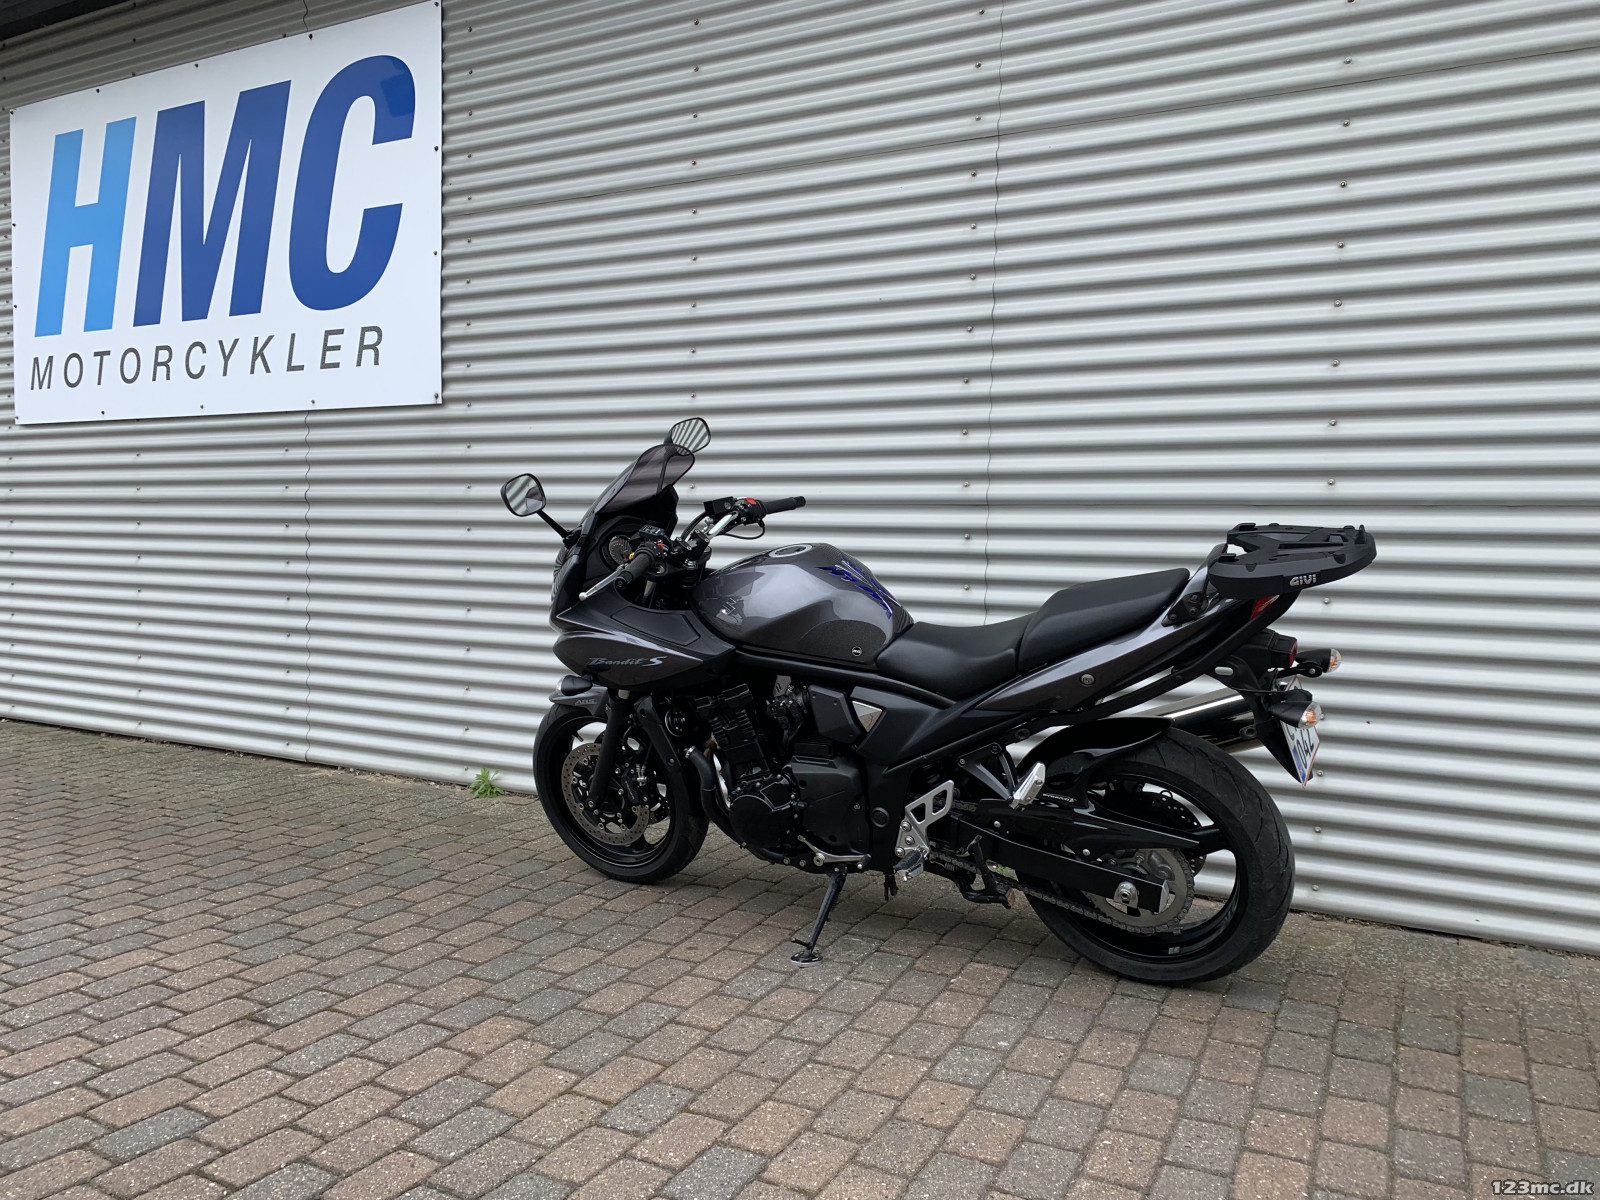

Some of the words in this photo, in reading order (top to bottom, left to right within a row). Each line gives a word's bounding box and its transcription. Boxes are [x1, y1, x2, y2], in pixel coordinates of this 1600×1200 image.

[34, 54, 417, 338] HMC
[30, 325, 384, 391] MOTORCYKLER
[588, 657, 648, 666] Bandit
[641, 655, 669, 668] S
